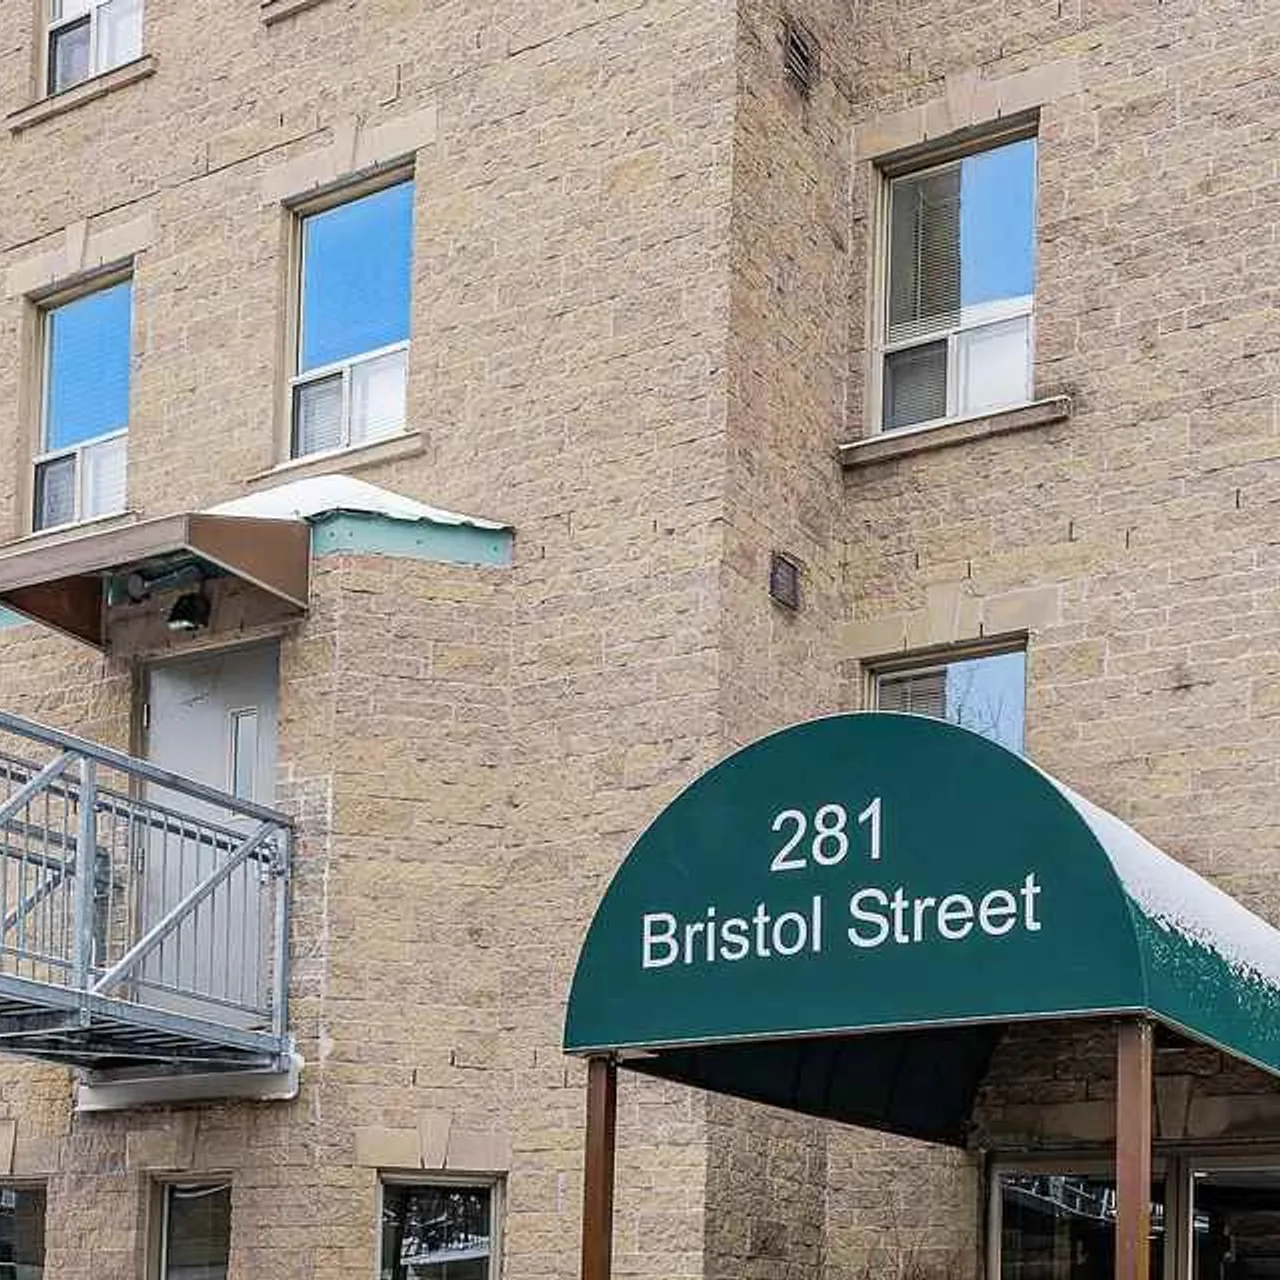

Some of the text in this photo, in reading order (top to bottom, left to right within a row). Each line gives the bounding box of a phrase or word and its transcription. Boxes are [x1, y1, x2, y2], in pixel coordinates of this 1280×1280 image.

[769, 796, 883, 872] 281
[641, 872, 1042, 969] Bristol Street
